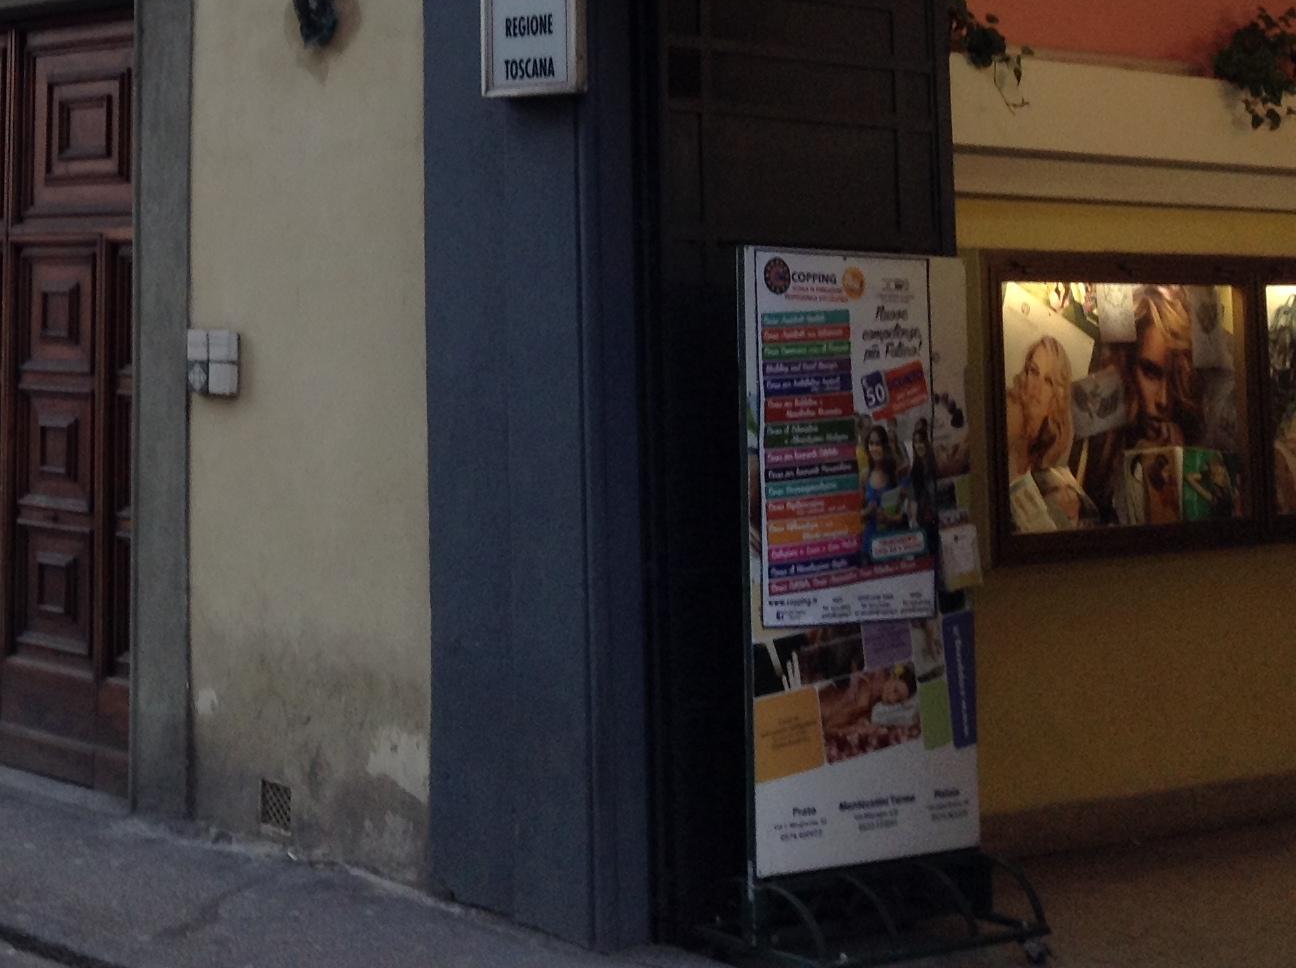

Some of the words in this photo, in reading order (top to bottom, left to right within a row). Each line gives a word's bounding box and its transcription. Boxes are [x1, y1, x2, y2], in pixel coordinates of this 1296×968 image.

[505, 14, 553, 38] REGIONE
[504, 55, 555, 81] TOSCANA
[791, 270, 837, 285] COPPING
[865, 383, 887, 407] 50
